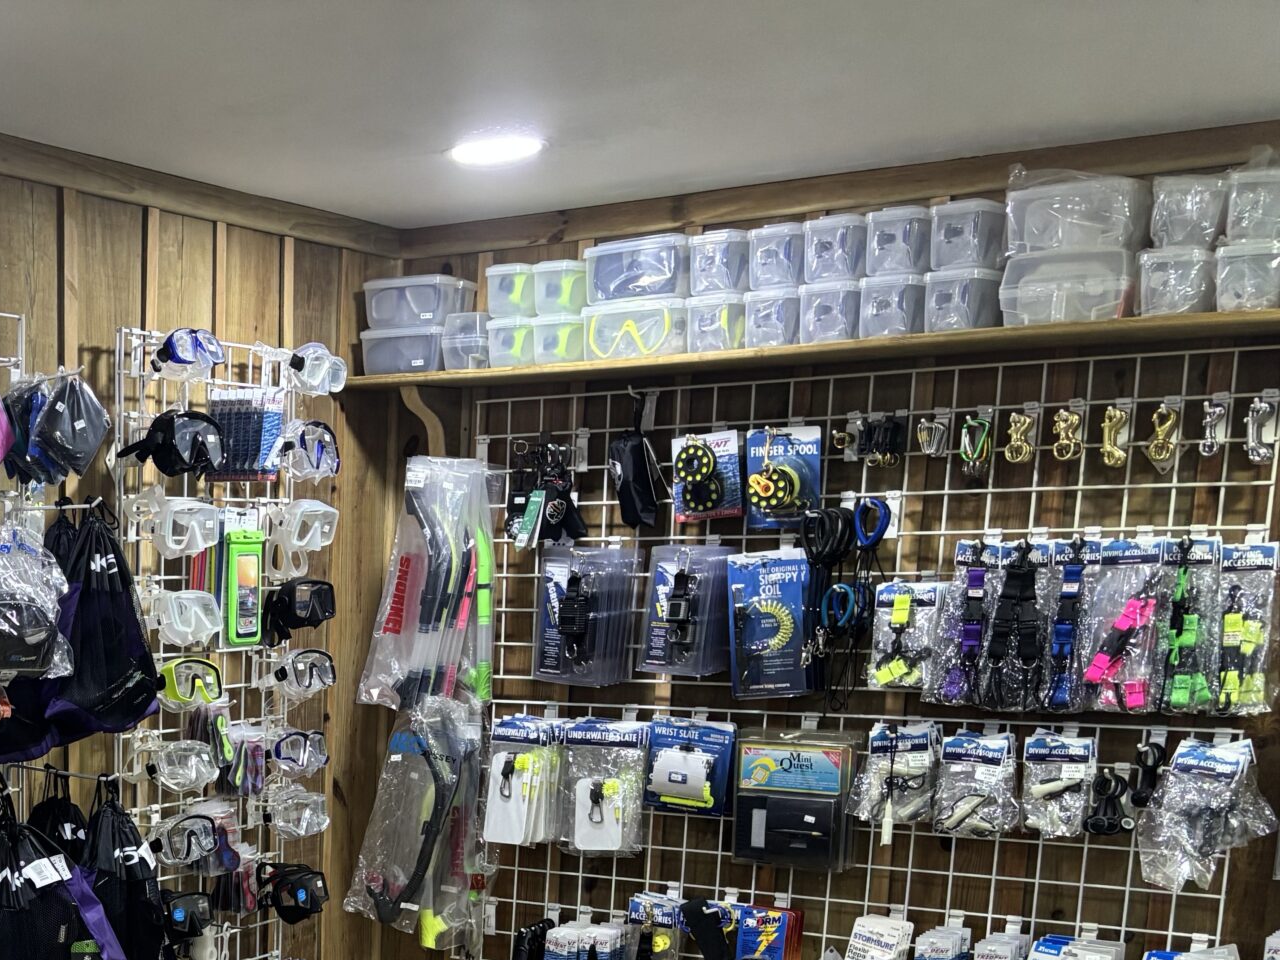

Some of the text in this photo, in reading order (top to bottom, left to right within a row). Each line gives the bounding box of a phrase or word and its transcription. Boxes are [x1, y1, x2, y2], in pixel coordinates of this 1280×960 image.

[750, 443, 818, 458] FINGER SPOOL
[1102, 547, 1159, 557] DIVING ACCESSORIES
[1232, 550, 1264, 559] DIVING
[1222, 557, 1274, 567] ACCESSORIES
[770, 565, 799, 574] ORIGINAL
[381, 555, 412, 636] SNORKEL
[759, 583, 782, 596] COIL
[568, 729, 614, 742] UNDERWATE
[654, 725, 678, 737] WRIST
[678, 728, 700, 740] SLATE
[872, 740, 891, 748] DIVING
[945, 746, 967, 754] DIVING
[788, 751, 812, 764] Mini
[1177, 757, 1199, 766] DIVING
[779, 757, 814, 773] Quest
[852, 931, 896, 951] STORMSURE
